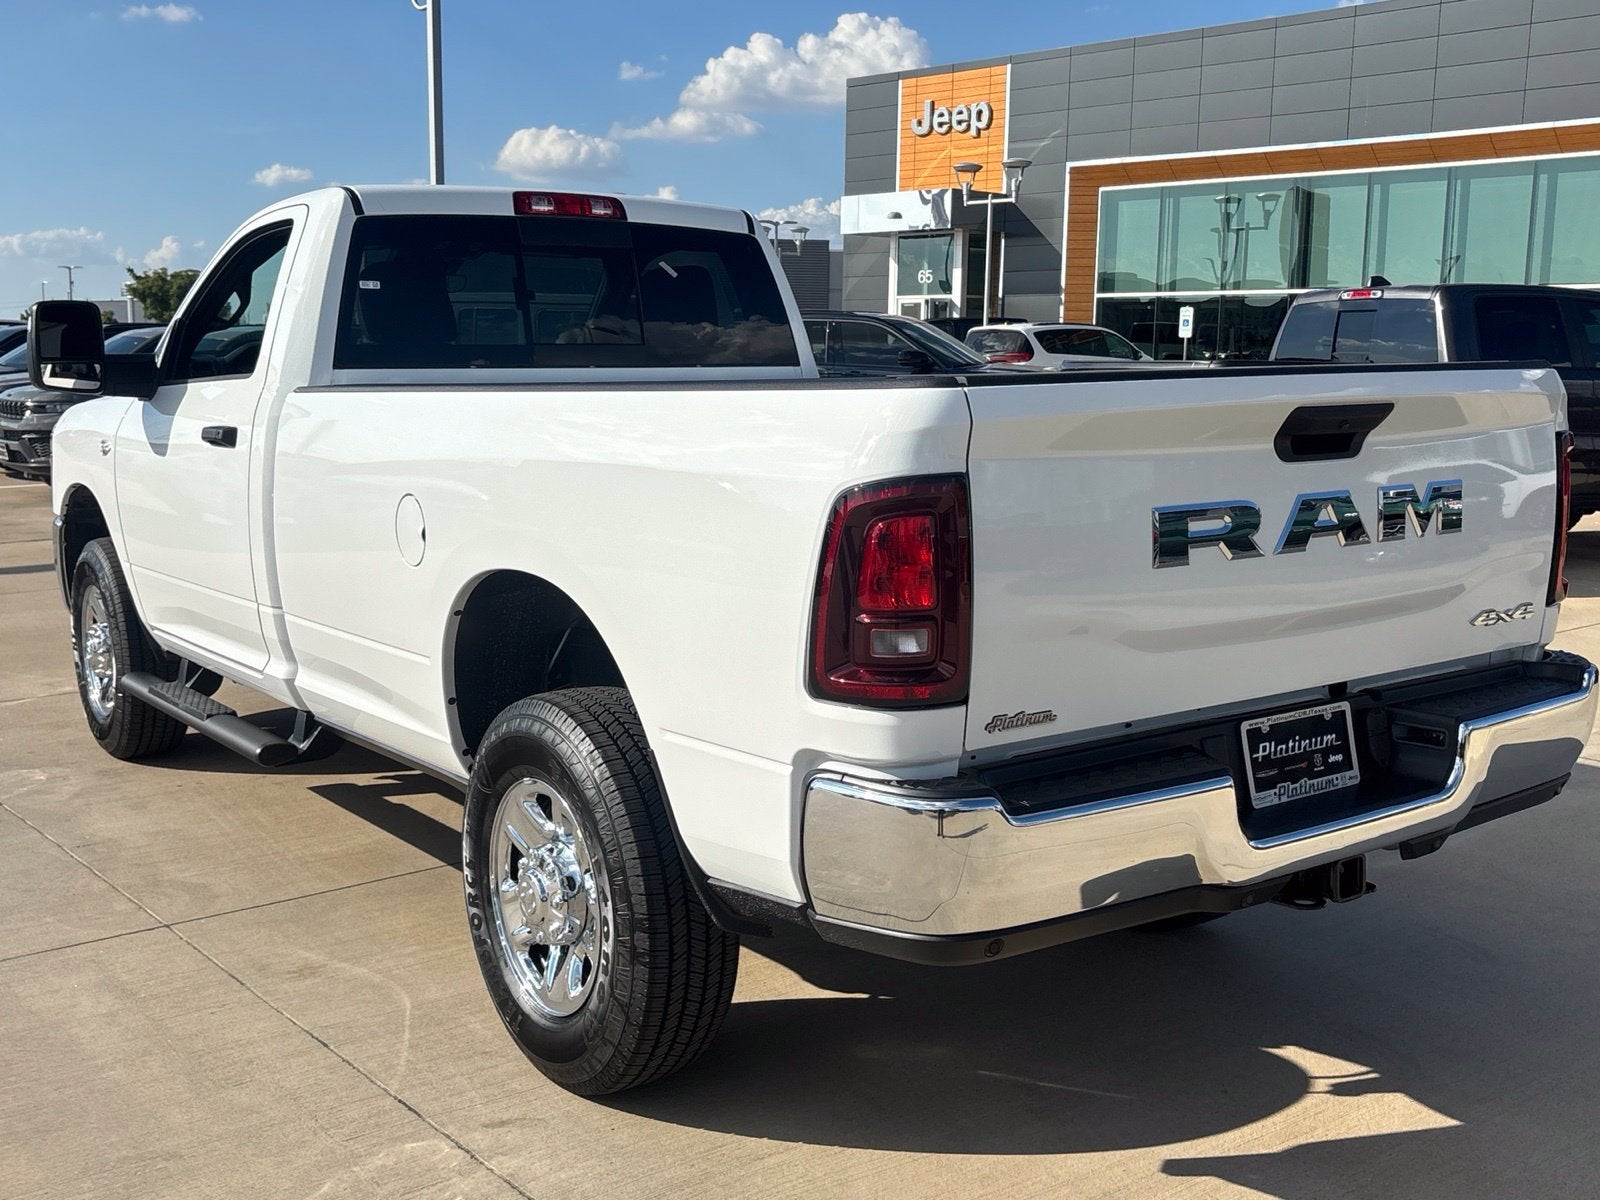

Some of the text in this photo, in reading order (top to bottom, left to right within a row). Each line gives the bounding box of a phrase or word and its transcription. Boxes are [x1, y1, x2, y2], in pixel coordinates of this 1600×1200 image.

[911, 99, 993, 139] Jeep
[918, 270, 933, 284] 65
[1152, 479, 1463, 569] RAM
[1469, 602, 1534, 626] 4x4
[984, 710, 1057, 734] Platinum
[1252, 733, 1342, 762] Platinum
[1328, 753, 1343, 763] Jeep
[1277, 778, 1341, 802] Platinum
